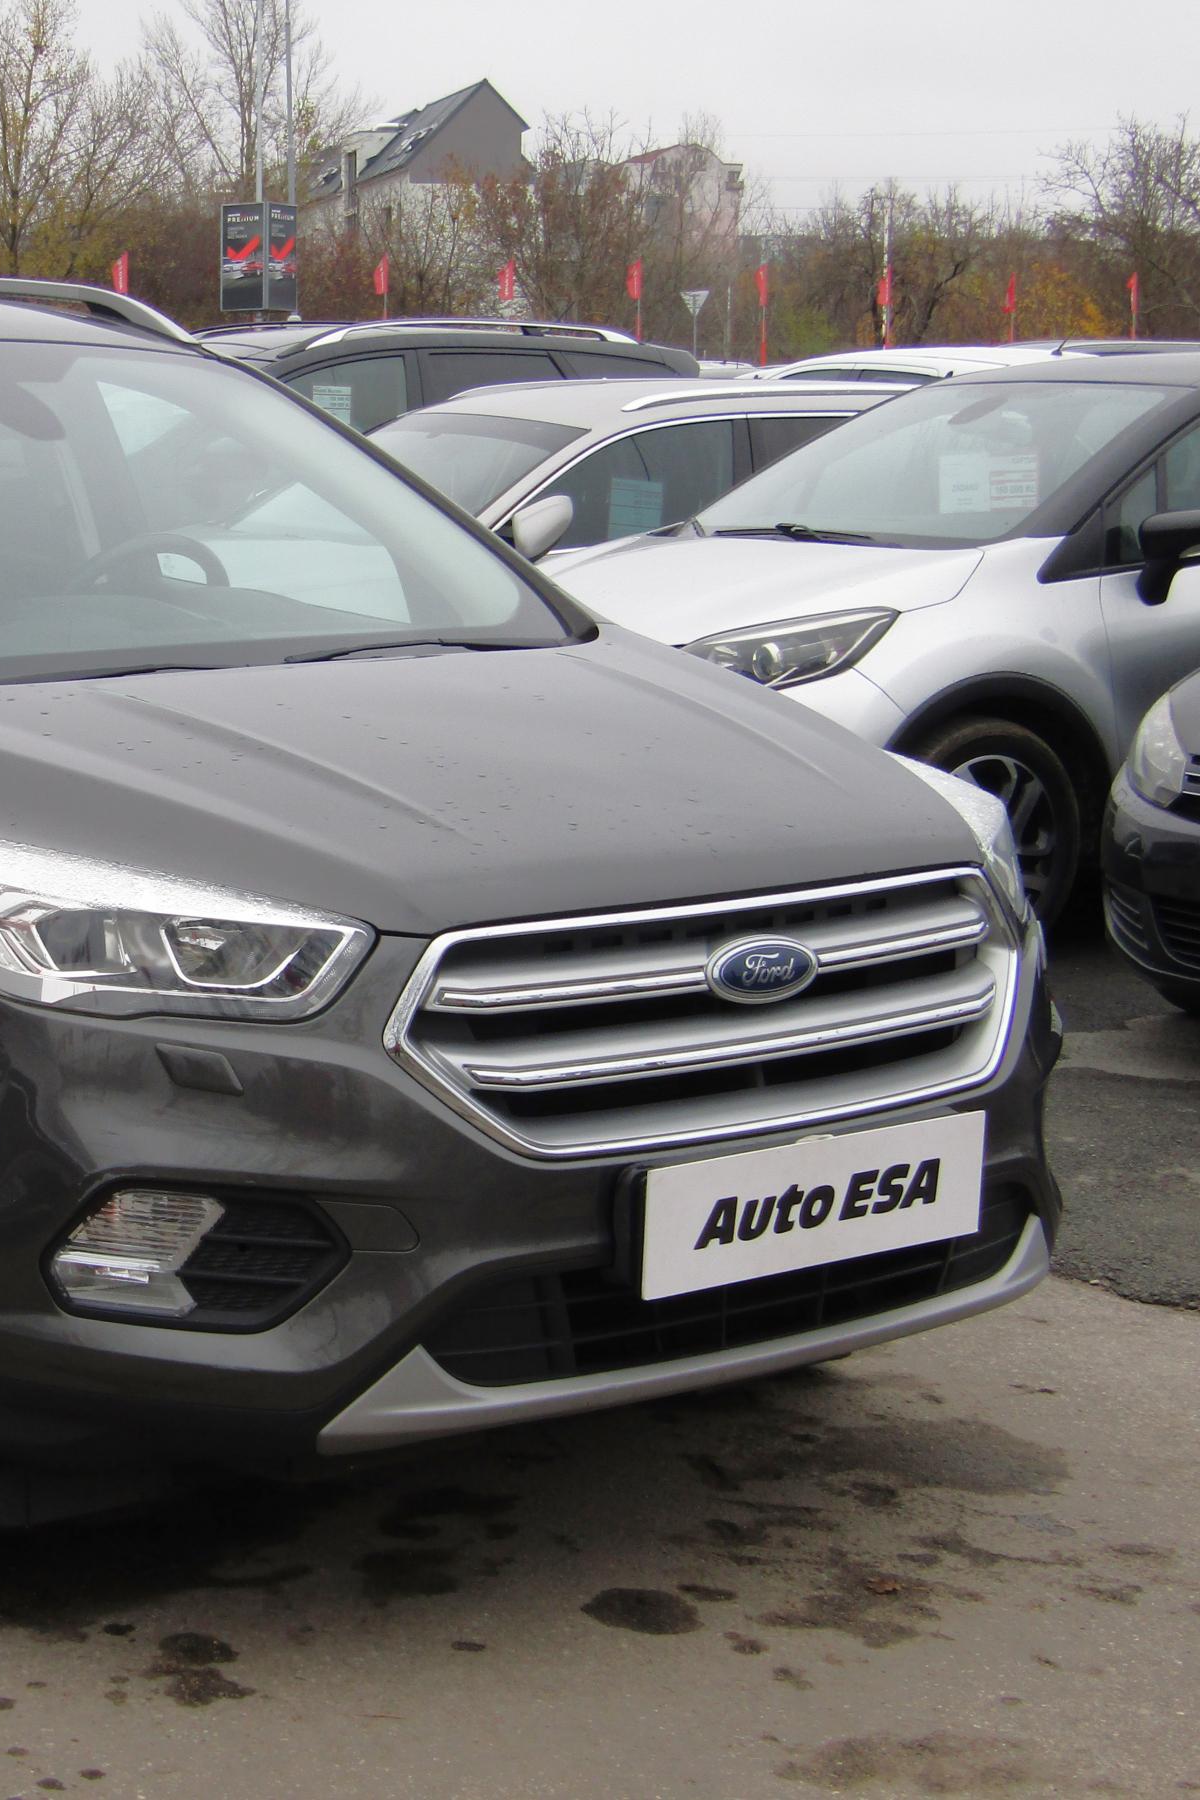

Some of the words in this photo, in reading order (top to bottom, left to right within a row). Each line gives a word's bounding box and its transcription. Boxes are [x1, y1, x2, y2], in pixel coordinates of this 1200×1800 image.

[742, 952, 796, 986] Ford
[694, 1183, 835, 1250] Auto
[838, 1157, 941, 1221] ESA
